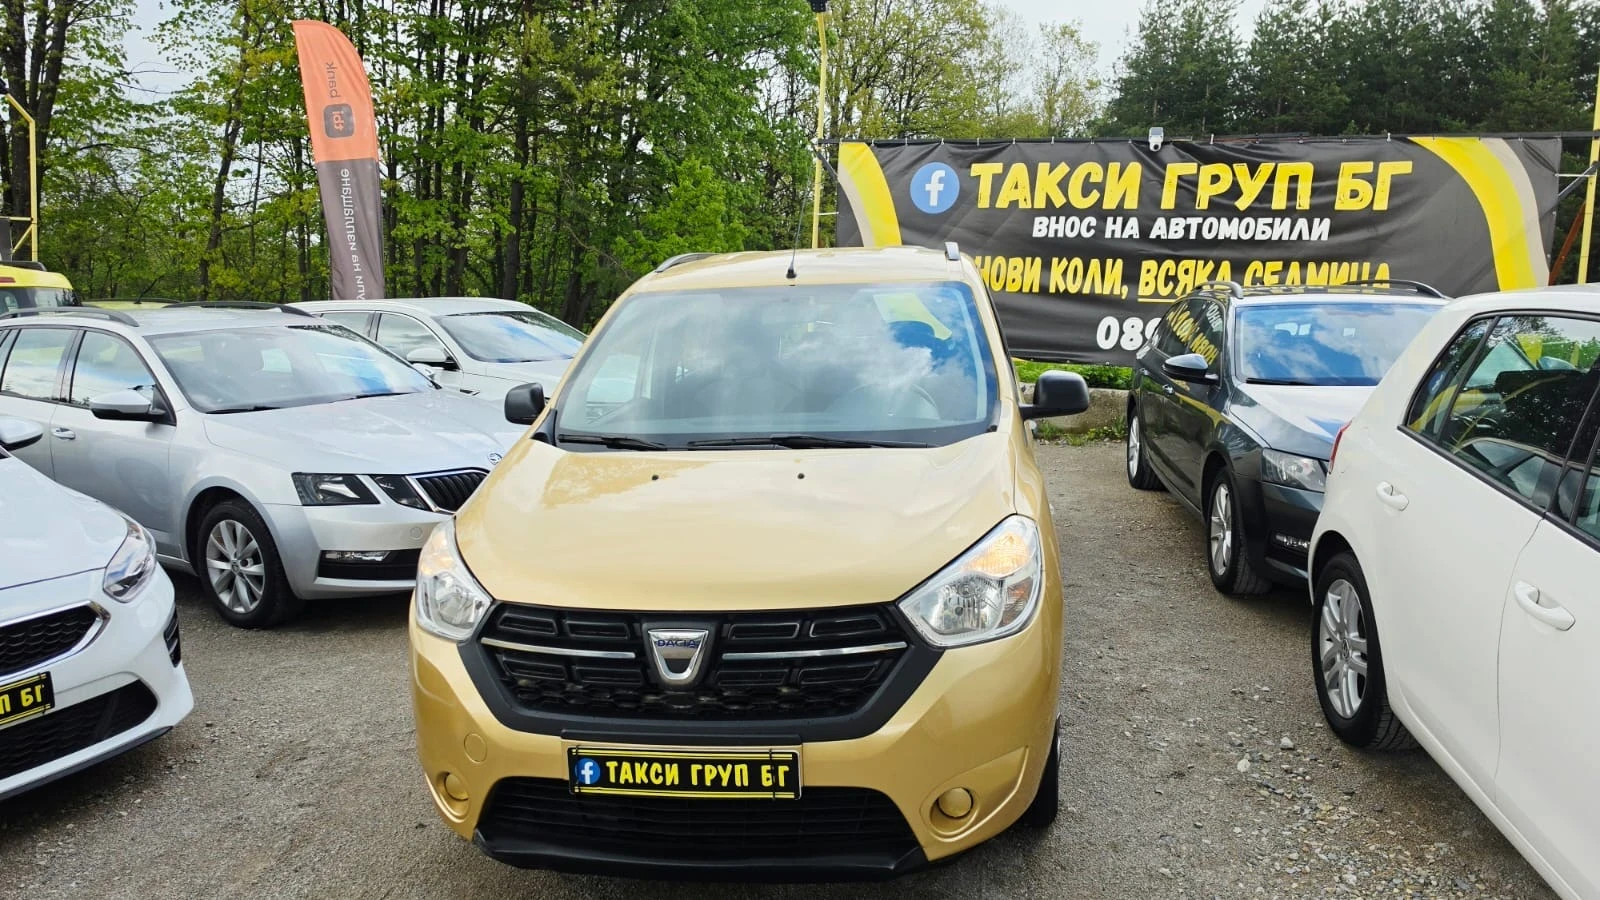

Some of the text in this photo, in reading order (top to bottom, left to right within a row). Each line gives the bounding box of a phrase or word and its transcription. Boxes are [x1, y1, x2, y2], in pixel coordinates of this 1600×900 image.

[970, 160, 1413, 211] ТАКСИ ГРУП БГ
[1032, 216, 1331, 241] ВНОС НА АВТОМОБИЛИ
[974, 255, 1042, 293] НОВИ
[1049, 257, 1129, 300] КОЛИ,
[1137, 259, 1232, 297] ВСЯКА
[656, 639, 698, 648] DACIA
[20, 683, 45, 708] БГ
[605, 760, 790, 787] ТАКСИ ГРУП БГ
